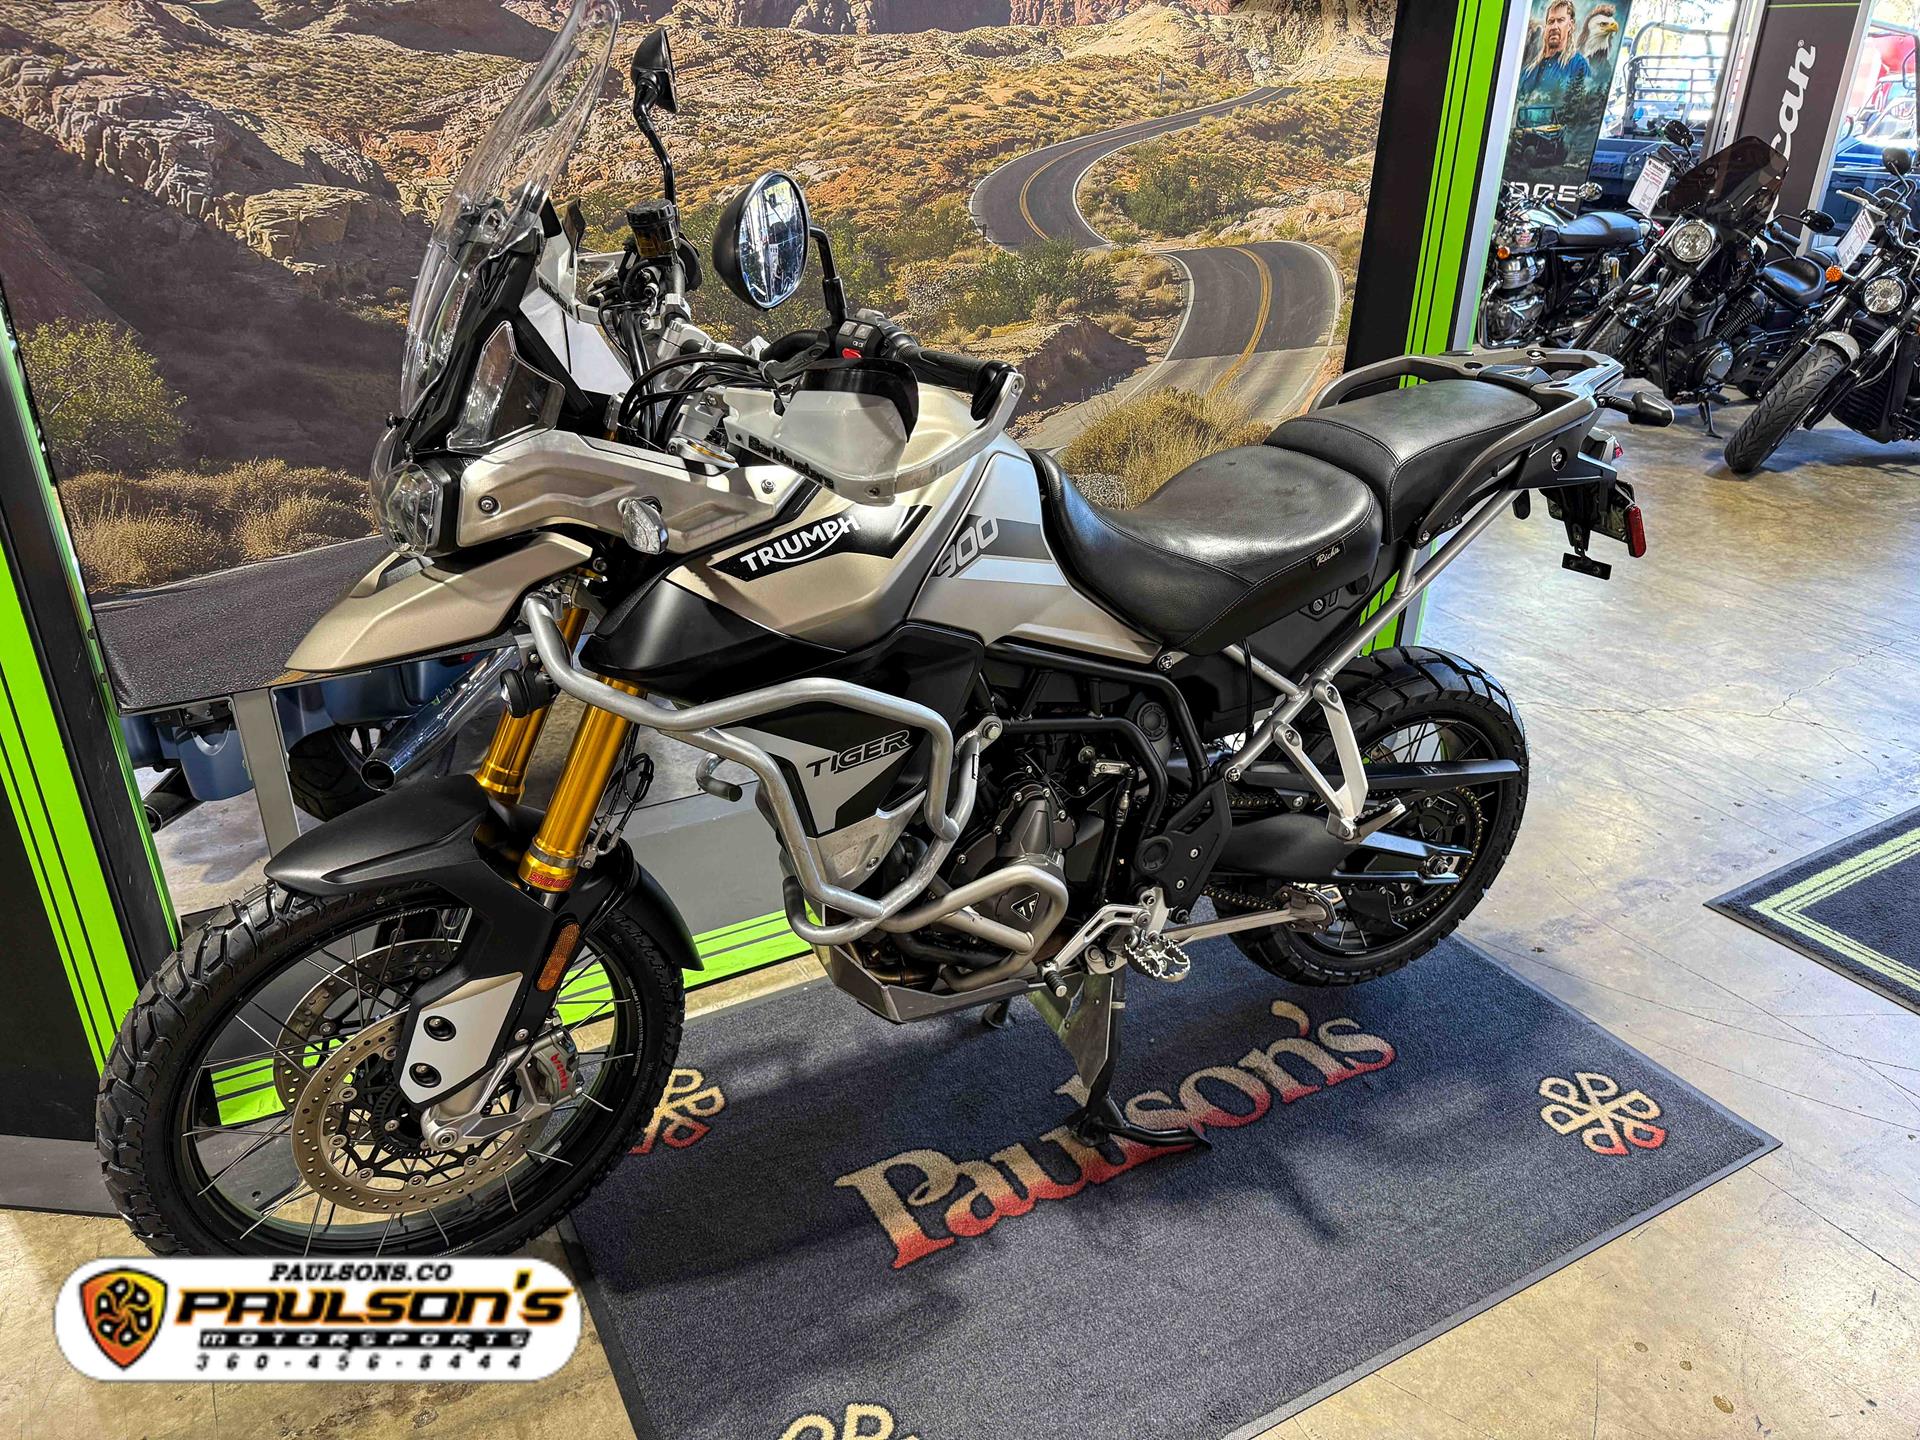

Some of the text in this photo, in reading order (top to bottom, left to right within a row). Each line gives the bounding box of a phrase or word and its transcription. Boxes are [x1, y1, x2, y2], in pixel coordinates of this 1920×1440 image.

[740, 514, 862, 573] TRIUMPH
[937, 512, 999, 580] 900
[804, 729, 914, 779] TIGER
